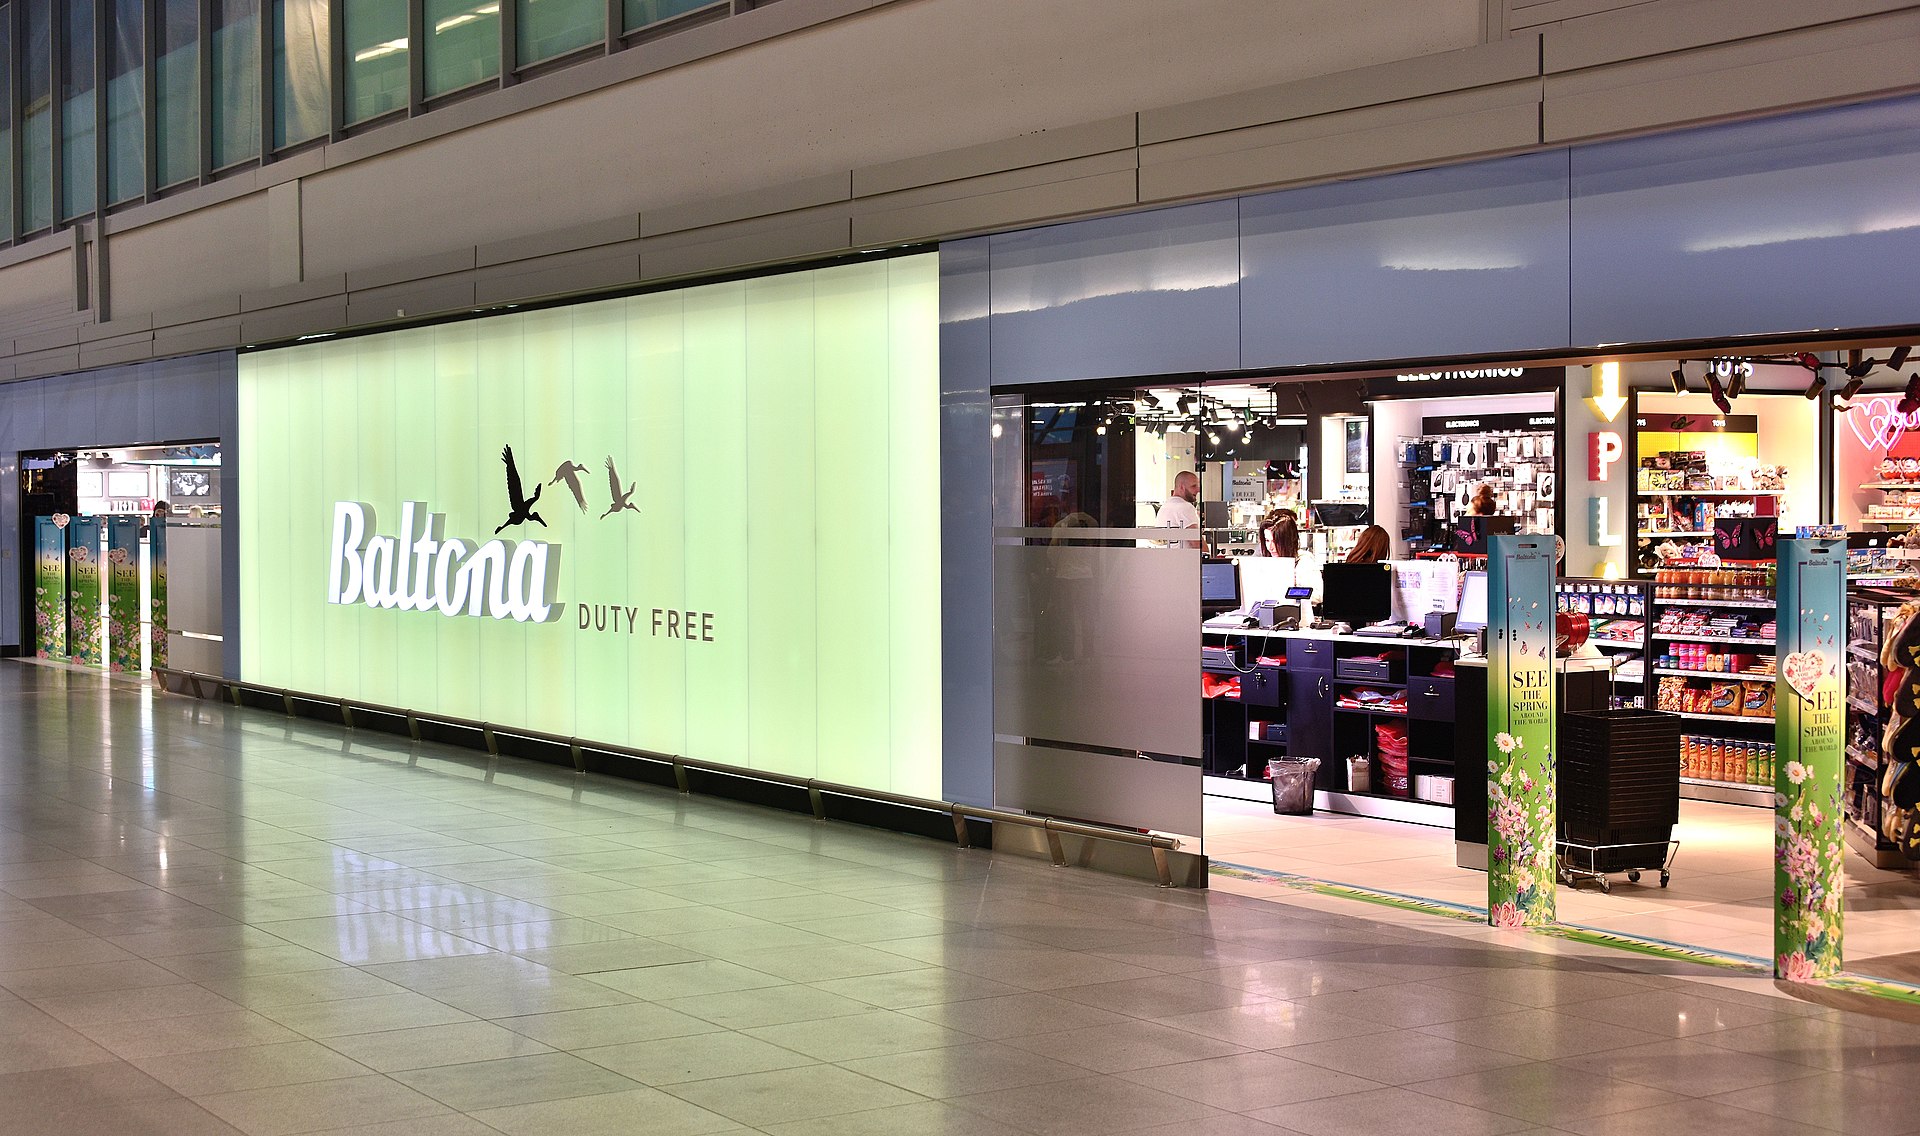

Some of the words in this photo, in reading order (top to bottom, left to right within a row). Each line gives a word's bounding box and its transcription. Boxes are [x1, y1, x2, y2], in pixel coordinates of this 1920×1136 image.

[328, 500, 566, 624] Baltona
[42, 564, 60, 572] SEE
[78, 567, 96, 575] SEE
[116, 569, 135, 578] SEE
[578, 602, 639, 635] DUTY
[651, 608, 716, 642] FREE
[1512, 670, 1548, 689] SEE
[1521, 690, 1542, 700] THE
[1512, 701, 1548, 712] SPRING
[1812, 713, 1832, 725] THE
[1804, 726, 1838, 738] SPRING
[1818, 744, 1838, 752] WORLD
